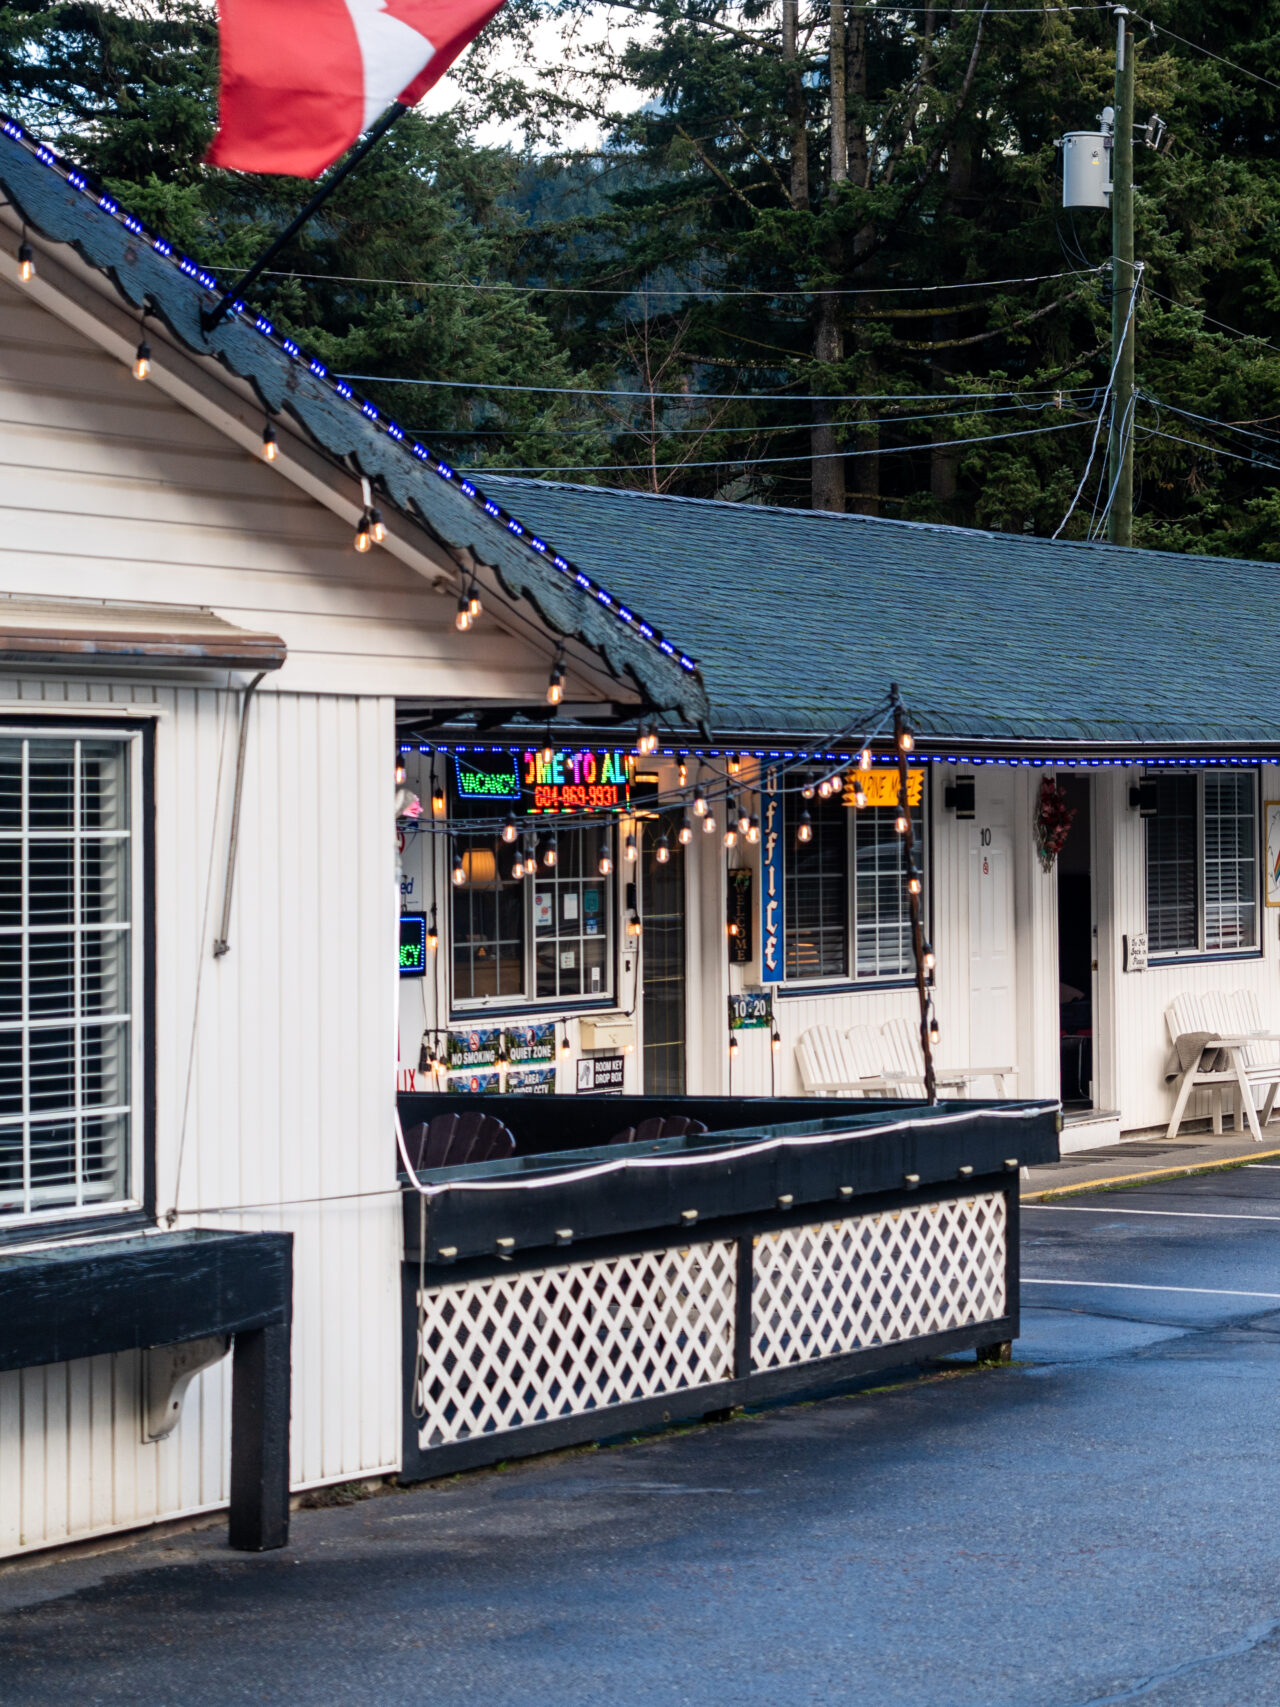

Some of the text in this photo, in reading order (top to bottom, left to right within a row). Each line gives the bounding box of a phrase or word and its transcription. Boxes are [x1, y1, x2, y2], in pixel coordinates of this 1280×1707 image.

[460, 772, 516, 794] VACANCY
[535, 785, 618, 807] 604-869-9931
[980, 827, 991, 847] 10
[734, 1001, 747, 1018] 10
[753, 999, 766, 1016] 20
[452, 1050, 495, 1066] NO SMOKING
[510, 1045, 551, 1060] QUIET ZONE
[595, 1060, 622, 1072] ROOM KEY
[524, 1073, 539, 1084] AREA
[595, 1072, 622, 1084] DROP BOX
